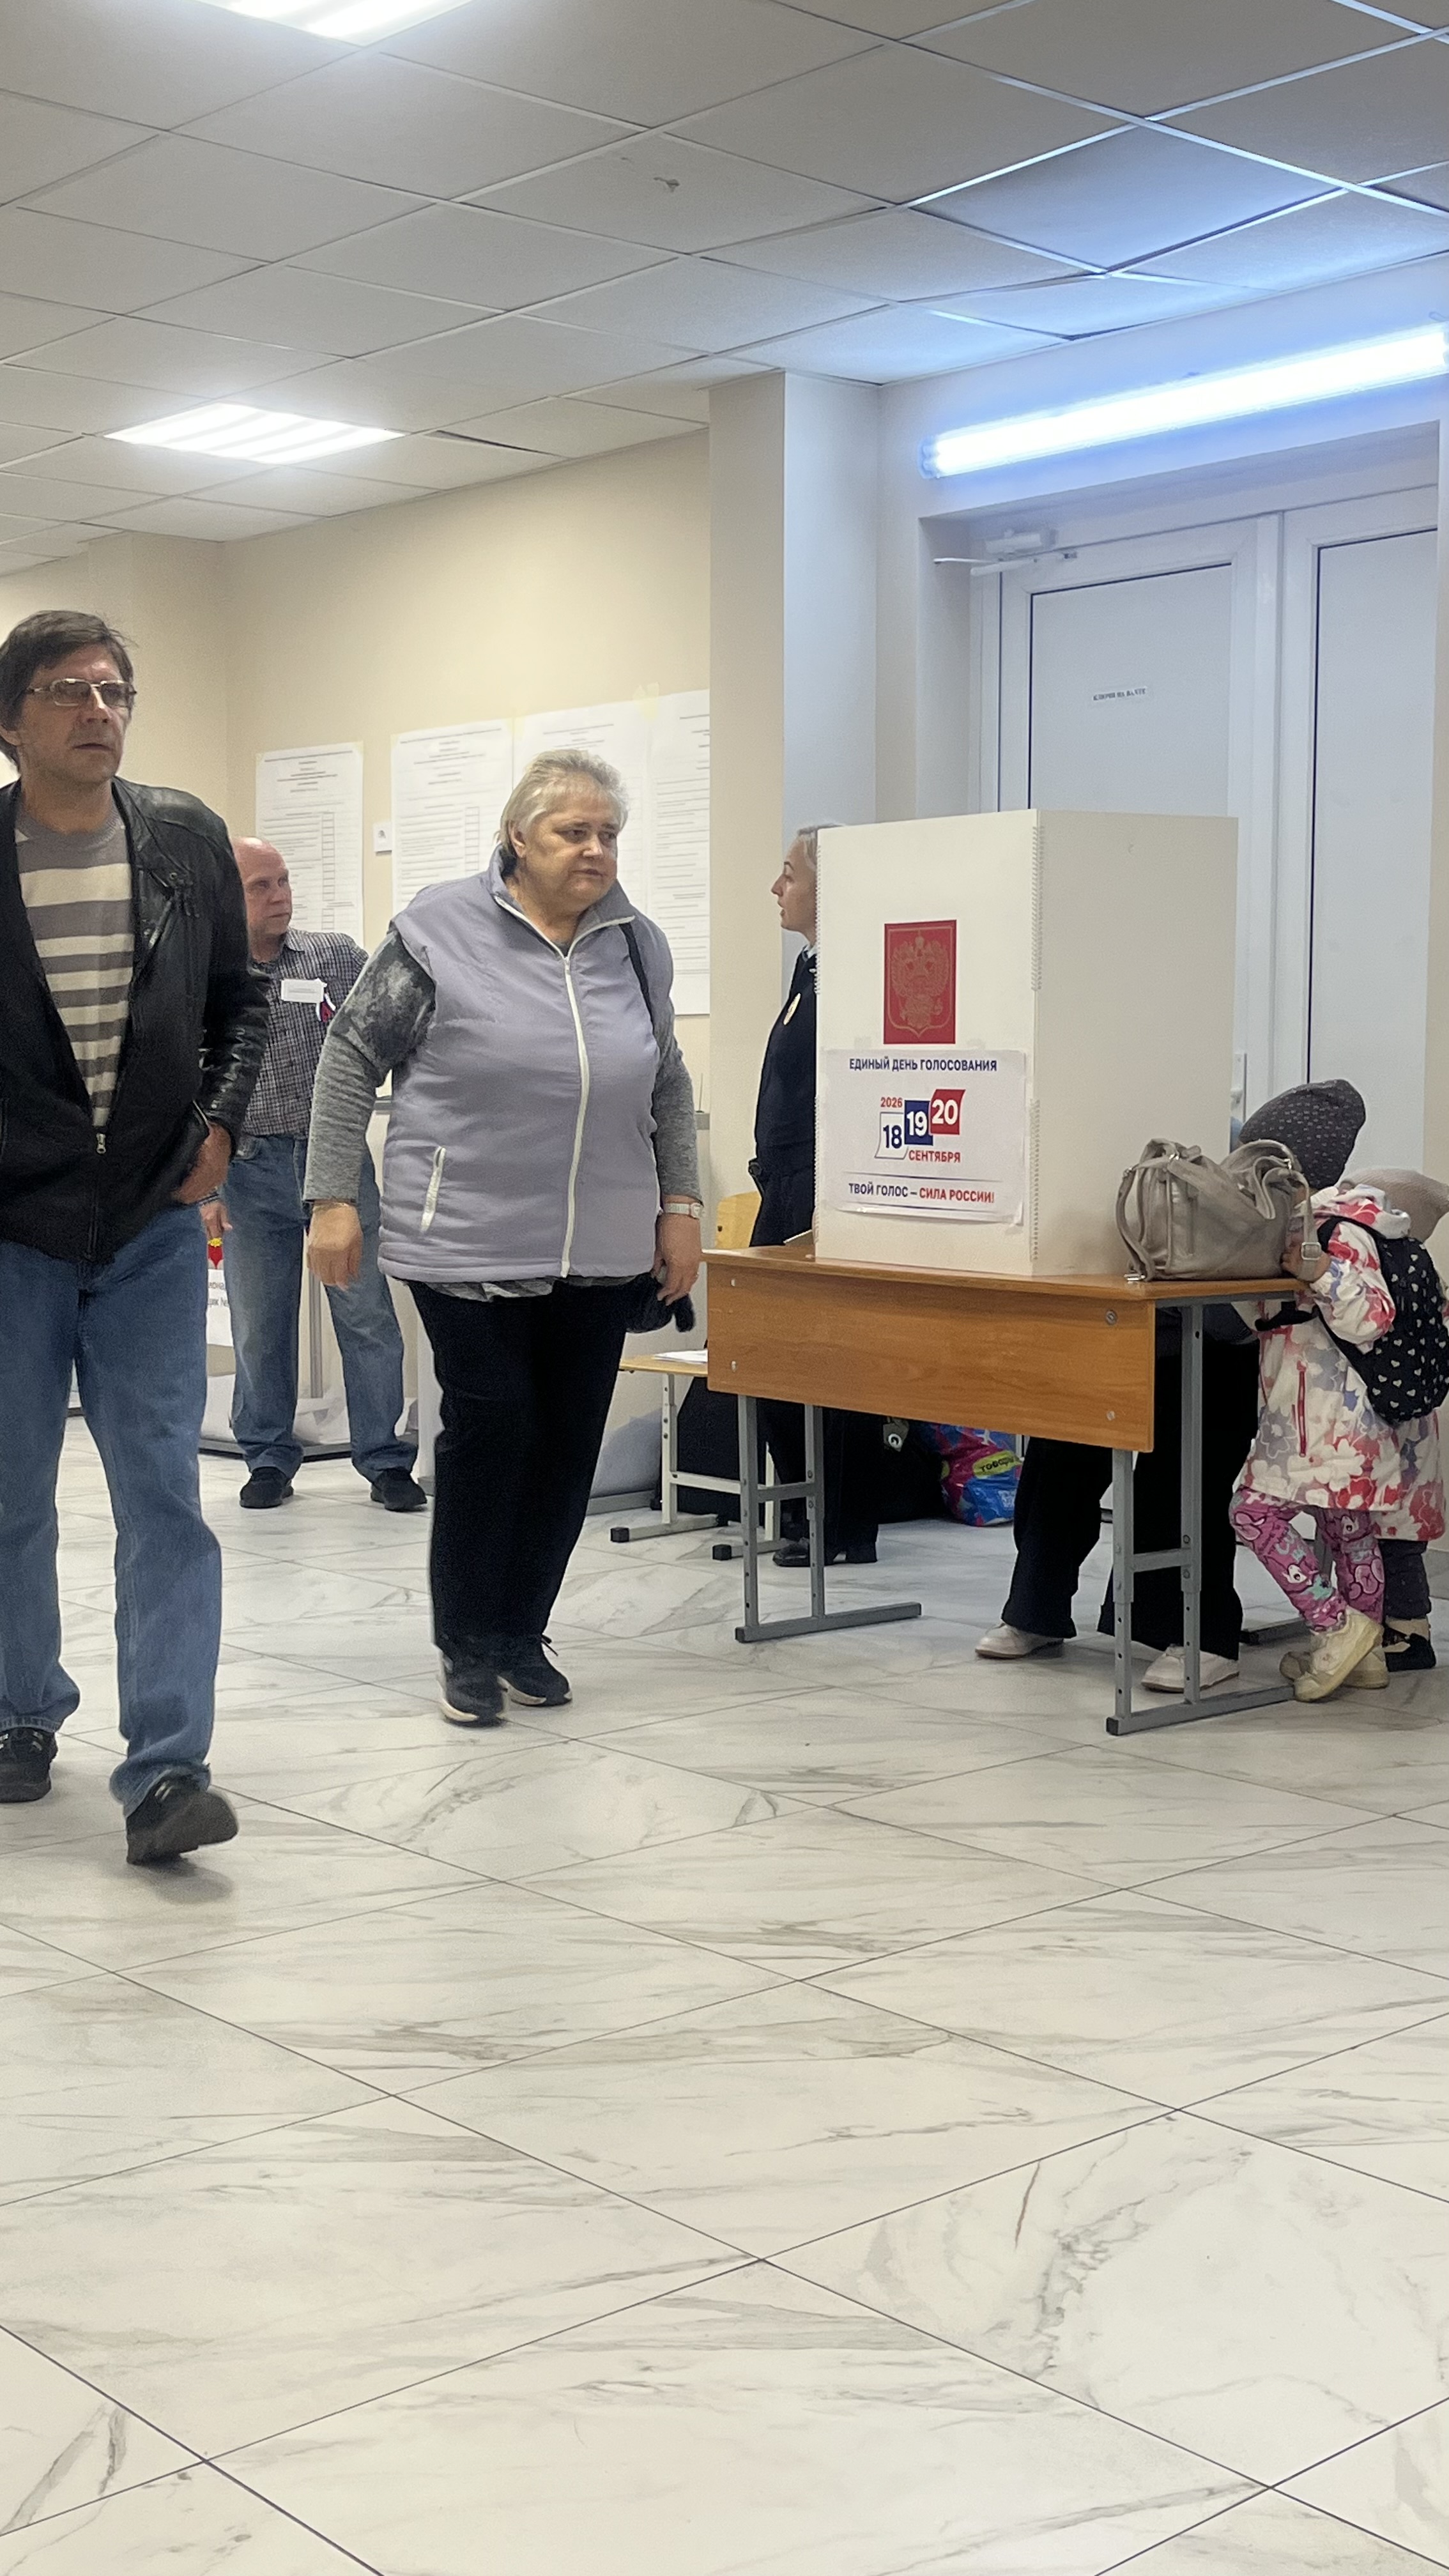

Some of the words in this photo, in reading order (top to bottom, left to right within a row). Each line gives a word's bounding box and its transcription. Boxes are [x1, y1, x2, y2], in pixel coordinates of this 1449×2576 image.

[849, 1056, 889, 1071] ЕДИНЫЙ
[892, 1059, 918, 1071] ДЕНЬ
[920, 1059, 997, 1071] ГОЛОСОВАНИЯ
[880, 1097, 903, 1108] 2026
[883, 1124, 902, 1149] 18
[907, 1111, 928, 1137] 19
[931, 1099, 958, 1125] 20
[908, 1150, 961, 1163] СЕНТЯБРЯ
[848, 1181, 874, 1195] ТВОЙ
[876, 1184, 907, 1197] ГОЛОС
[919, 1187, 947, 1200] СИЛА
[949, 1190, 995, 1203] РОССИИ!
